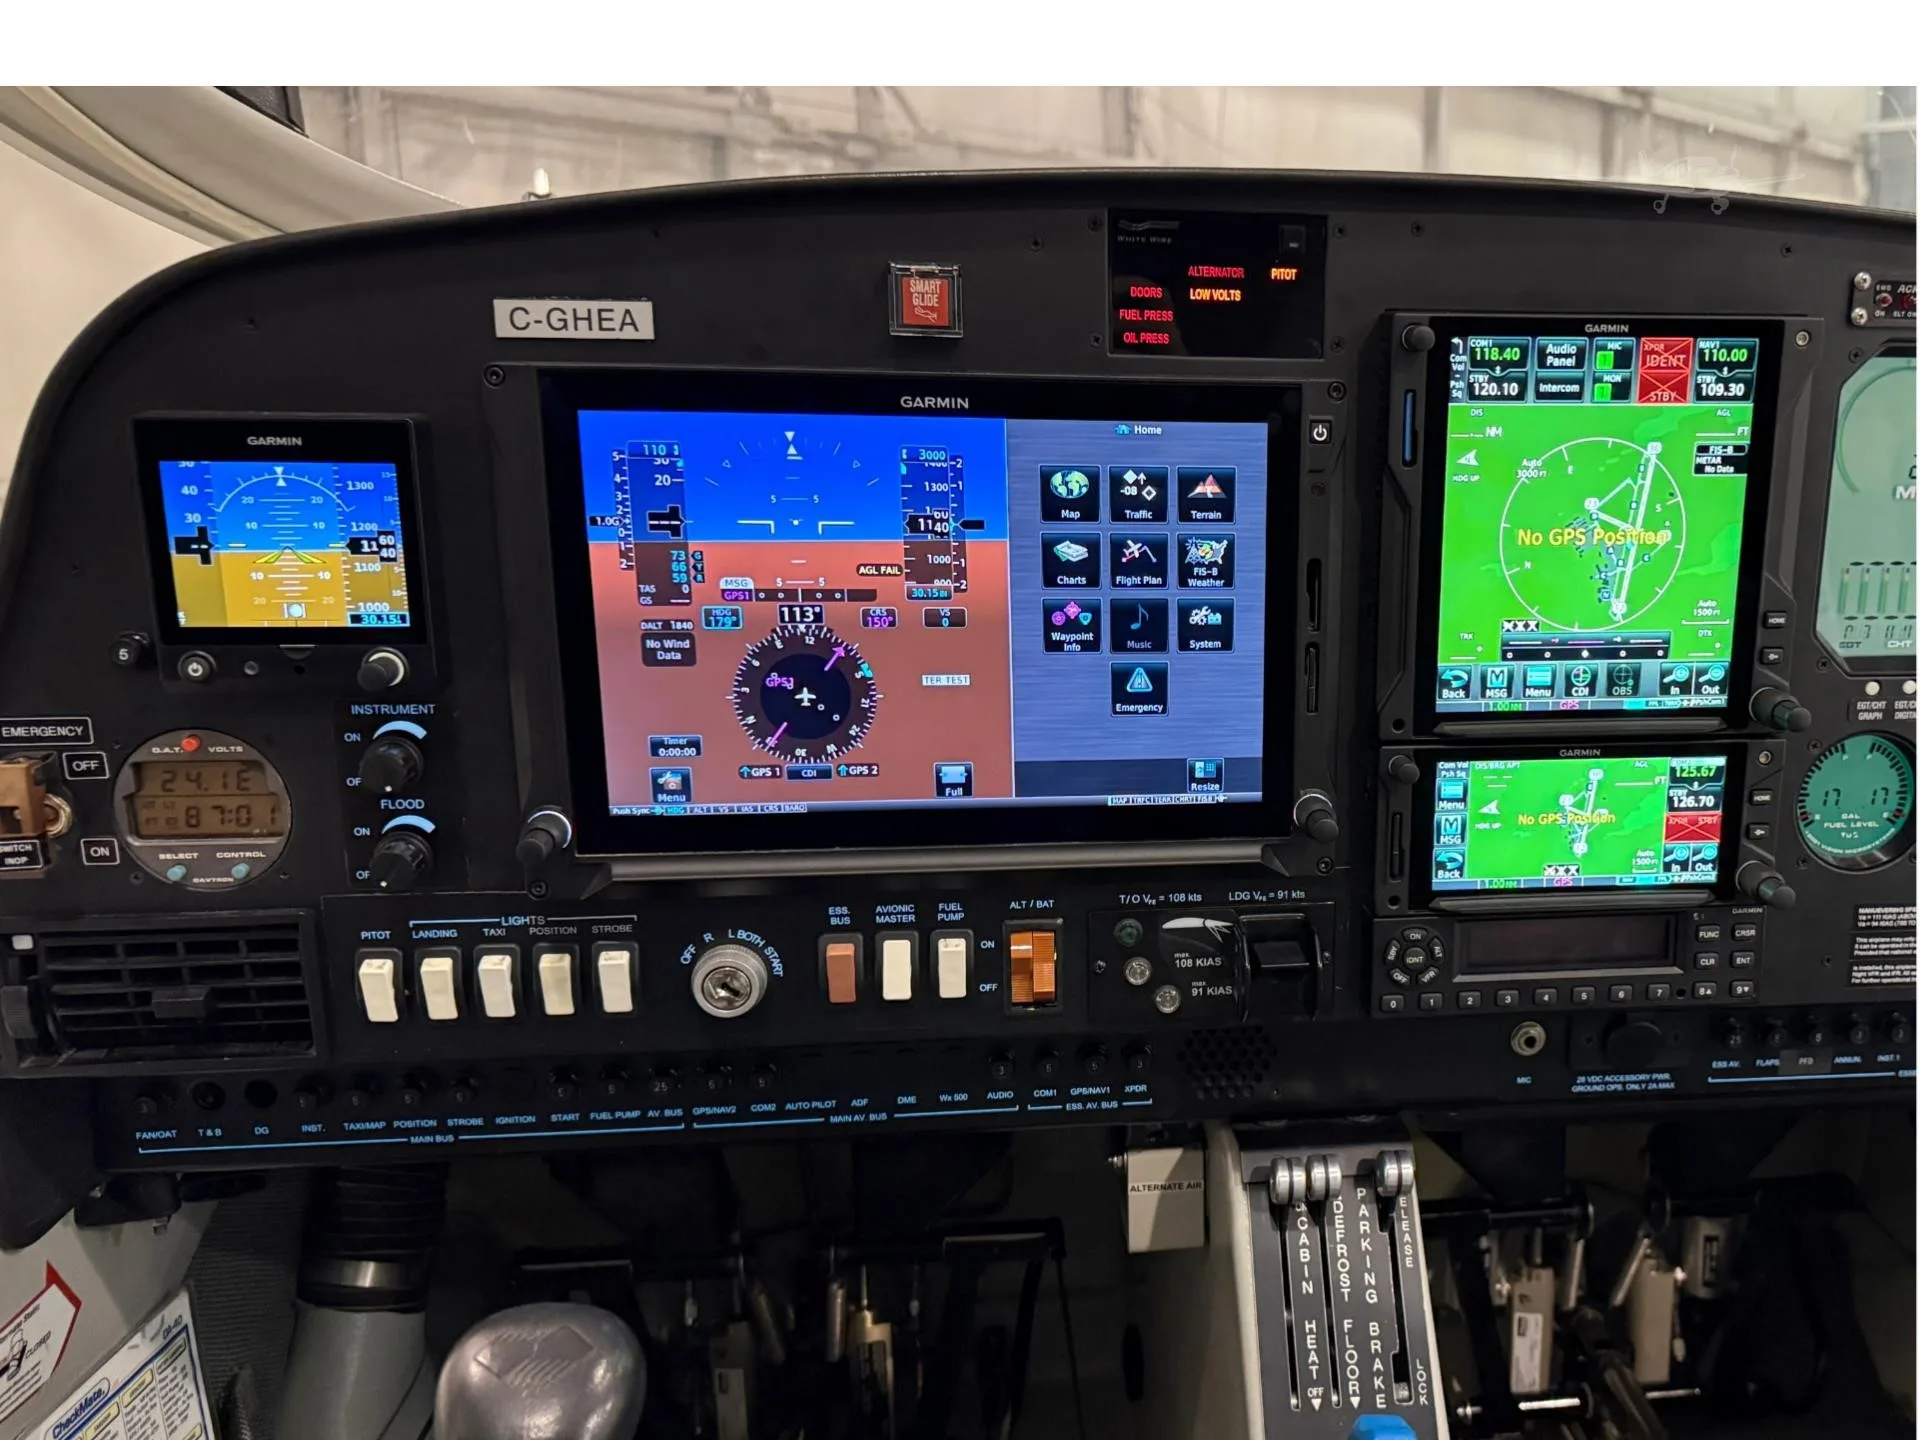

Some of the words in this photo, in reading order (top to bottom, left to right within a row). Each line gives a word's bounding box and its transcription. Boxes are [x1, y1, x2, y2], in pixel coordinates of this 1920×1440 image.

[1188, 266, 1245, 278] ALTERNATOR
[1271, 268, 1297, 280] PITOT
[910, 279, 941, 295] SMART
[1130, 287, 1163, 298] DOORS
[1190, 288, 1210, 300] LOW
[1212, 289, 1242, 301] VOLTS
[912, 293, 939, 307] GLIDE
[509, 307, 639, 332] C-GHEA
[1119, 309, 1142, 320] FUEL
[1144, 310, 1174, 321] PRESS
[1585, 325, 1629, 333] GARMIN
[1124, 332, 1138, 343] OIL
[1140, 333, 1170, 344] PRESS
[1546, 344, 1577, 354] Audio
[1475, 348, 1520, 361] 118.40
[1704, 350, 1747, 362] 110.00
[1547, 356, 1576, 367] Panel
[1646, 355, 1686, 368] IDENT
[1473, 383, 1518, 396] 120.10
[1539, 383, 1580, 393] Intercom
[1700, 384, 1744, 397] 109.30
[1650, 391, 1675, 401] STBY
[900, 396, 969, 410] GARMIN
[1134, 425, 1162, 434] Home
[247, 436, 302, 447] GARMIN
[919, 449, 946, 460] 3000
[181, 485, 198, 496] 40
[346, 481, 374, 491] 1300
[924, 481, 949, 491] 1300
[184, 512, 202, 524] 30
[1061, 510, 1080, 520] Map
[1124, 510, 1152, 519] Traffic
[1191, 511, 1222, 519] Terrain
[351, 522, 378, 531] 1200
[595, 517, 620, 526] 1.0G
[1518, 529, 1542, 545] No
[1549, 529, 1585, 545] GPS
[859, 566, 878, 574] AGL
[880, 566, 900, 575] FAIL
[1057, 576, 1086, 584] Charts
[1116, 576, 1143, 587] Flight
[1145, 576, 1162, 584] Plan
[1188, 579, 1224, 587] Weather
[724, 591, 749, 600] GPS1
[911, 588, 939, 598] 30.15
[357, 602, 389, 612] 1000
[641, 622, 662, 630] DALT
[670, 621, 693, 630] 1840
[1051, 632, 1093, 643] Waypoint
[646, 640, 661, 648] No
[663, 639, 690, 648] Wind
[1064, 643, 1081, 652] Info
[1127, 640, 1152, 649] Music
[1189, 640, 1221, 650] System
[657, 652, 681, 660] Data
[1443, 689, 1465, 698] Back
[1486, 689, 1507, 698] MSG
[1525, 688, 1551, 697] Menu
[1572, 687, 1588, 696] CDI
[1613, 686, 1632, 695] OBS
[1702, 686, 1719, 694] Out
[351, 704, 435, 716] INSTRUMENT
[1116, 704, 1163, 714] Emergency
[2, 726, 83, 738] EMERGENCY
[344, 733, 360, 742] ON
[72, 761, 98, 772] OFF
[1675, 766, 1715, 778] 125.67
[946, 787, 962, 796] Full
[1191, 783, 1219, 791] Resize
[657, 793, 686, 802] Menu
[1673, 796, 1714, 808] 126.70
[381, 799, 424, 810] FLOOD
[1439, 800, 1464, 810] Menu
[1518, 813, 1535, 825] No
[1538, 813, 1565, 825] GPS
[354, 827, 370, 836] ON
[90, 847, 110, 857] ON
[216, 851, 266, 859] CONTROL
[1695, 862, 1713, 871] Out
[1438, 869, 1460, 879] Back
[1168, 892, 1186, 902] 108
[1188, 892, 1202, 902] kts
[1228, 891, 1248, 901] LDG
[1277, 890, 1287, 899] 91
[1289, 889, 1305, 899] kts
[875, 904, 914, 914] AVIONIC
[938, 902, 962, 911] FUEL
[1010, 901, 1028, 910] ALT
[1036, 900, 1054, 909] BAT
[829, 906, 849, 916] ESS.
[502, 916, 545, 926] LIGHTS
[830, 916, 850, 925] BUS
[876, 913, 915, 924] MASTER
[937, 912, 964, 921] PUMP
[483, 928, 506, 937] TAXI
[529, 926, 577, 936] POSITION
[591, 924, 632, 934] STROBE
[361, 931, 390, 940] PITOT
[412, 929, 457, 940] LANDING
[703, 932, 714, 942] R
[729, 929, 736, 939] L
[737, 930, 766, 948] BOTH
[1700, 930, 1719, 939] FUNC
[980, 941, 995, 949] ON
[679, 944, 698, 965] OFF
[764, 947, 783, 978] START
[1174, 960, 1193, 968] 108
[1196, 957, 1222, 967] KIAS
[1700, 957, 1715, 966] CLR
[979, 983, 997, 992] OFF
[1192, 987, 1203, 996] 91
[1206, 985, 1233, 995] KIAS
[1517, 1076, 1532, 1084] MIC
[987, 1090, 1014, 1099] AUDIO
[1033, 1088, 1057, 1097] COM1
[751, 1103, 776, 1112] COM2
[785, 1101, 809, 1110] AUTO
[812, 1100, 836, 1109] PILOT
[551, 1113, 580, 1122] START
[590, 1112, 612, 1121] FUEL
[394, 1119, 437, 1128] POSITION
[1130, 1182, 1183, 1192] ALTERNATE
[1185, 1181, 1201, 1190] AIR
[1297, 1217, 1313, 1295] CABIN
[1305, 1320, 1319, 1379] HEAT
[1333, 1201, 1350, 1302] DEFROST
[1343, 1319, 1360, 1393] FLOOR
[1357, 1188, 1378, 1303] PARKING
[1369, 1323, 1387, 1408] BRAKE
[1416, 1359, 1429, 1405] LOCK
[1307, 1387, 1324, 1397] OFF
